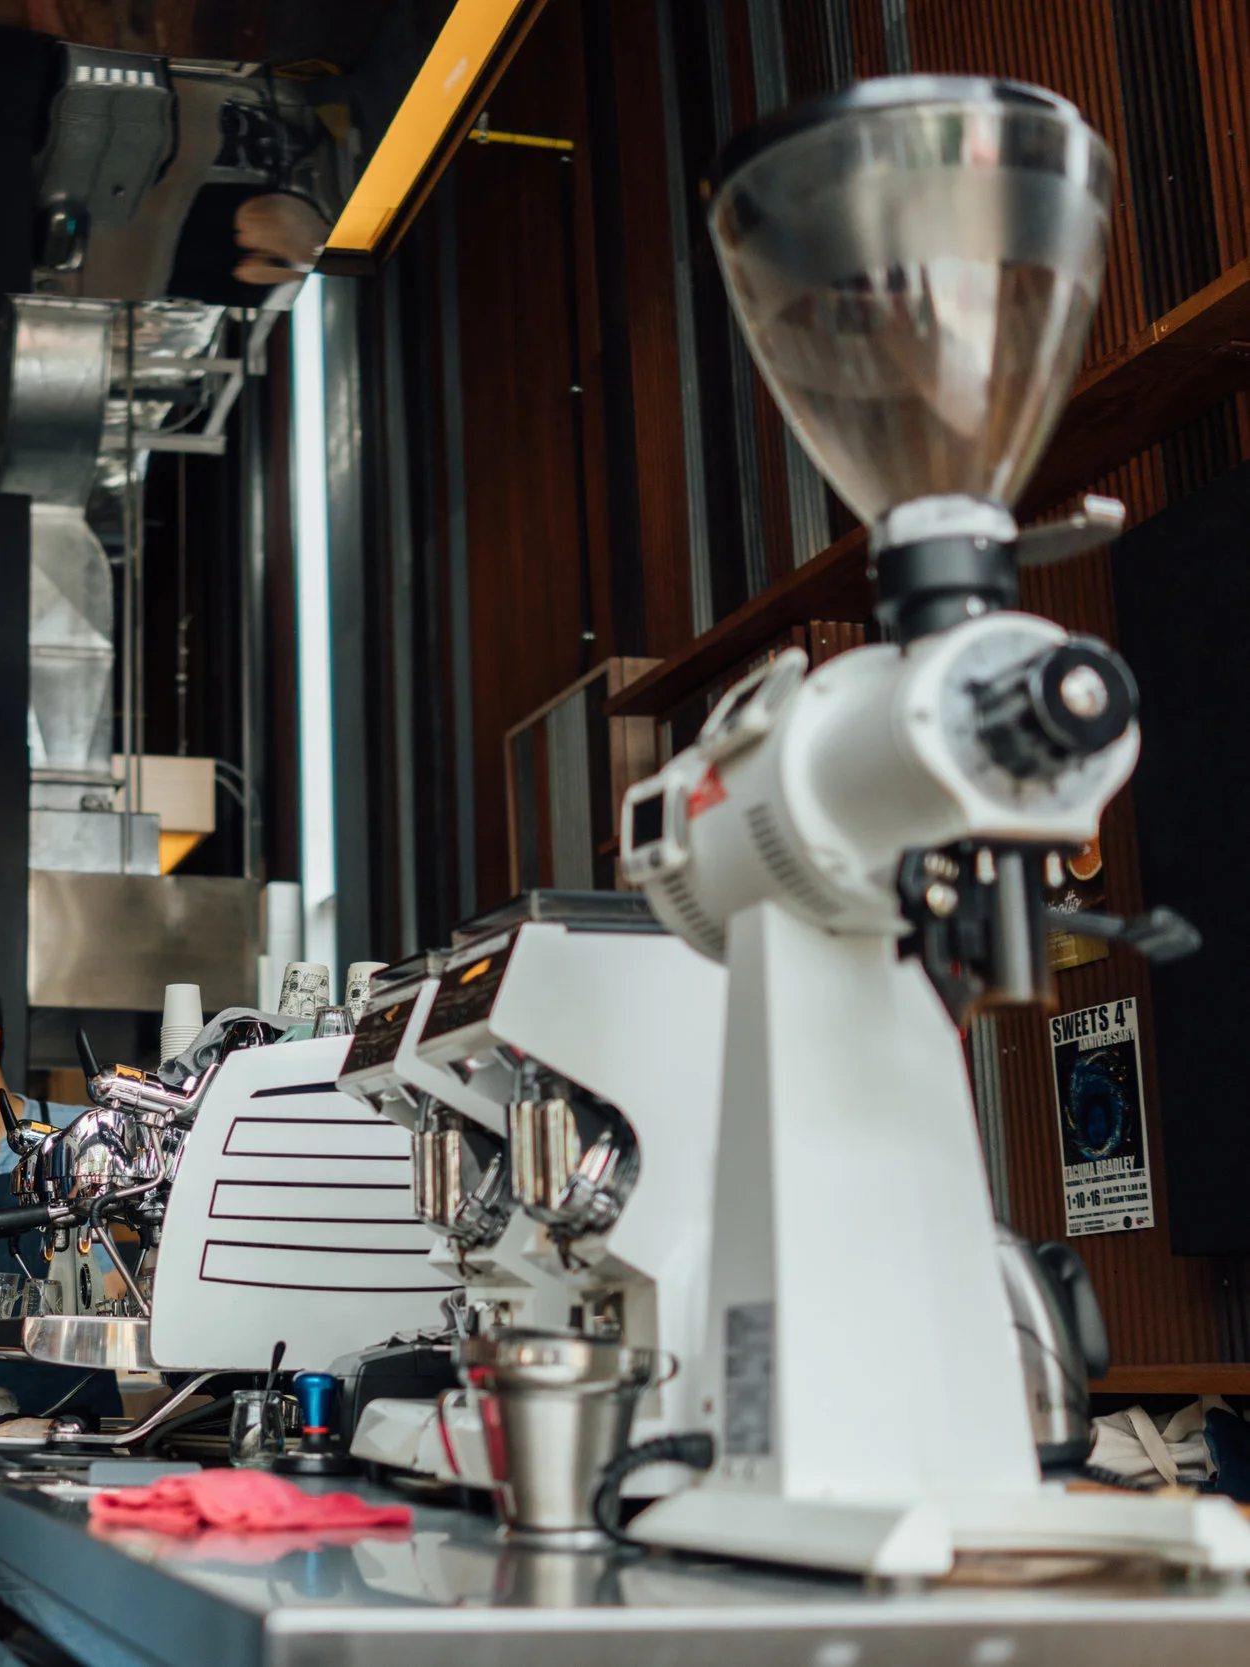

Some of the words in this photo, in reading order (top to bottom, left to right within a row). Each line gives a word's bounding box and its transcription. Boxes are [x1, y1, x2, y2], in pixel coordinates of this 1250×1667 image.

[1052, 1005, 1109, 1044] SWEETS
[1078, 1027, 1135, 1052] ANNIVERSARY
[1095, 1155, 1135, 1176] BRADLEY
